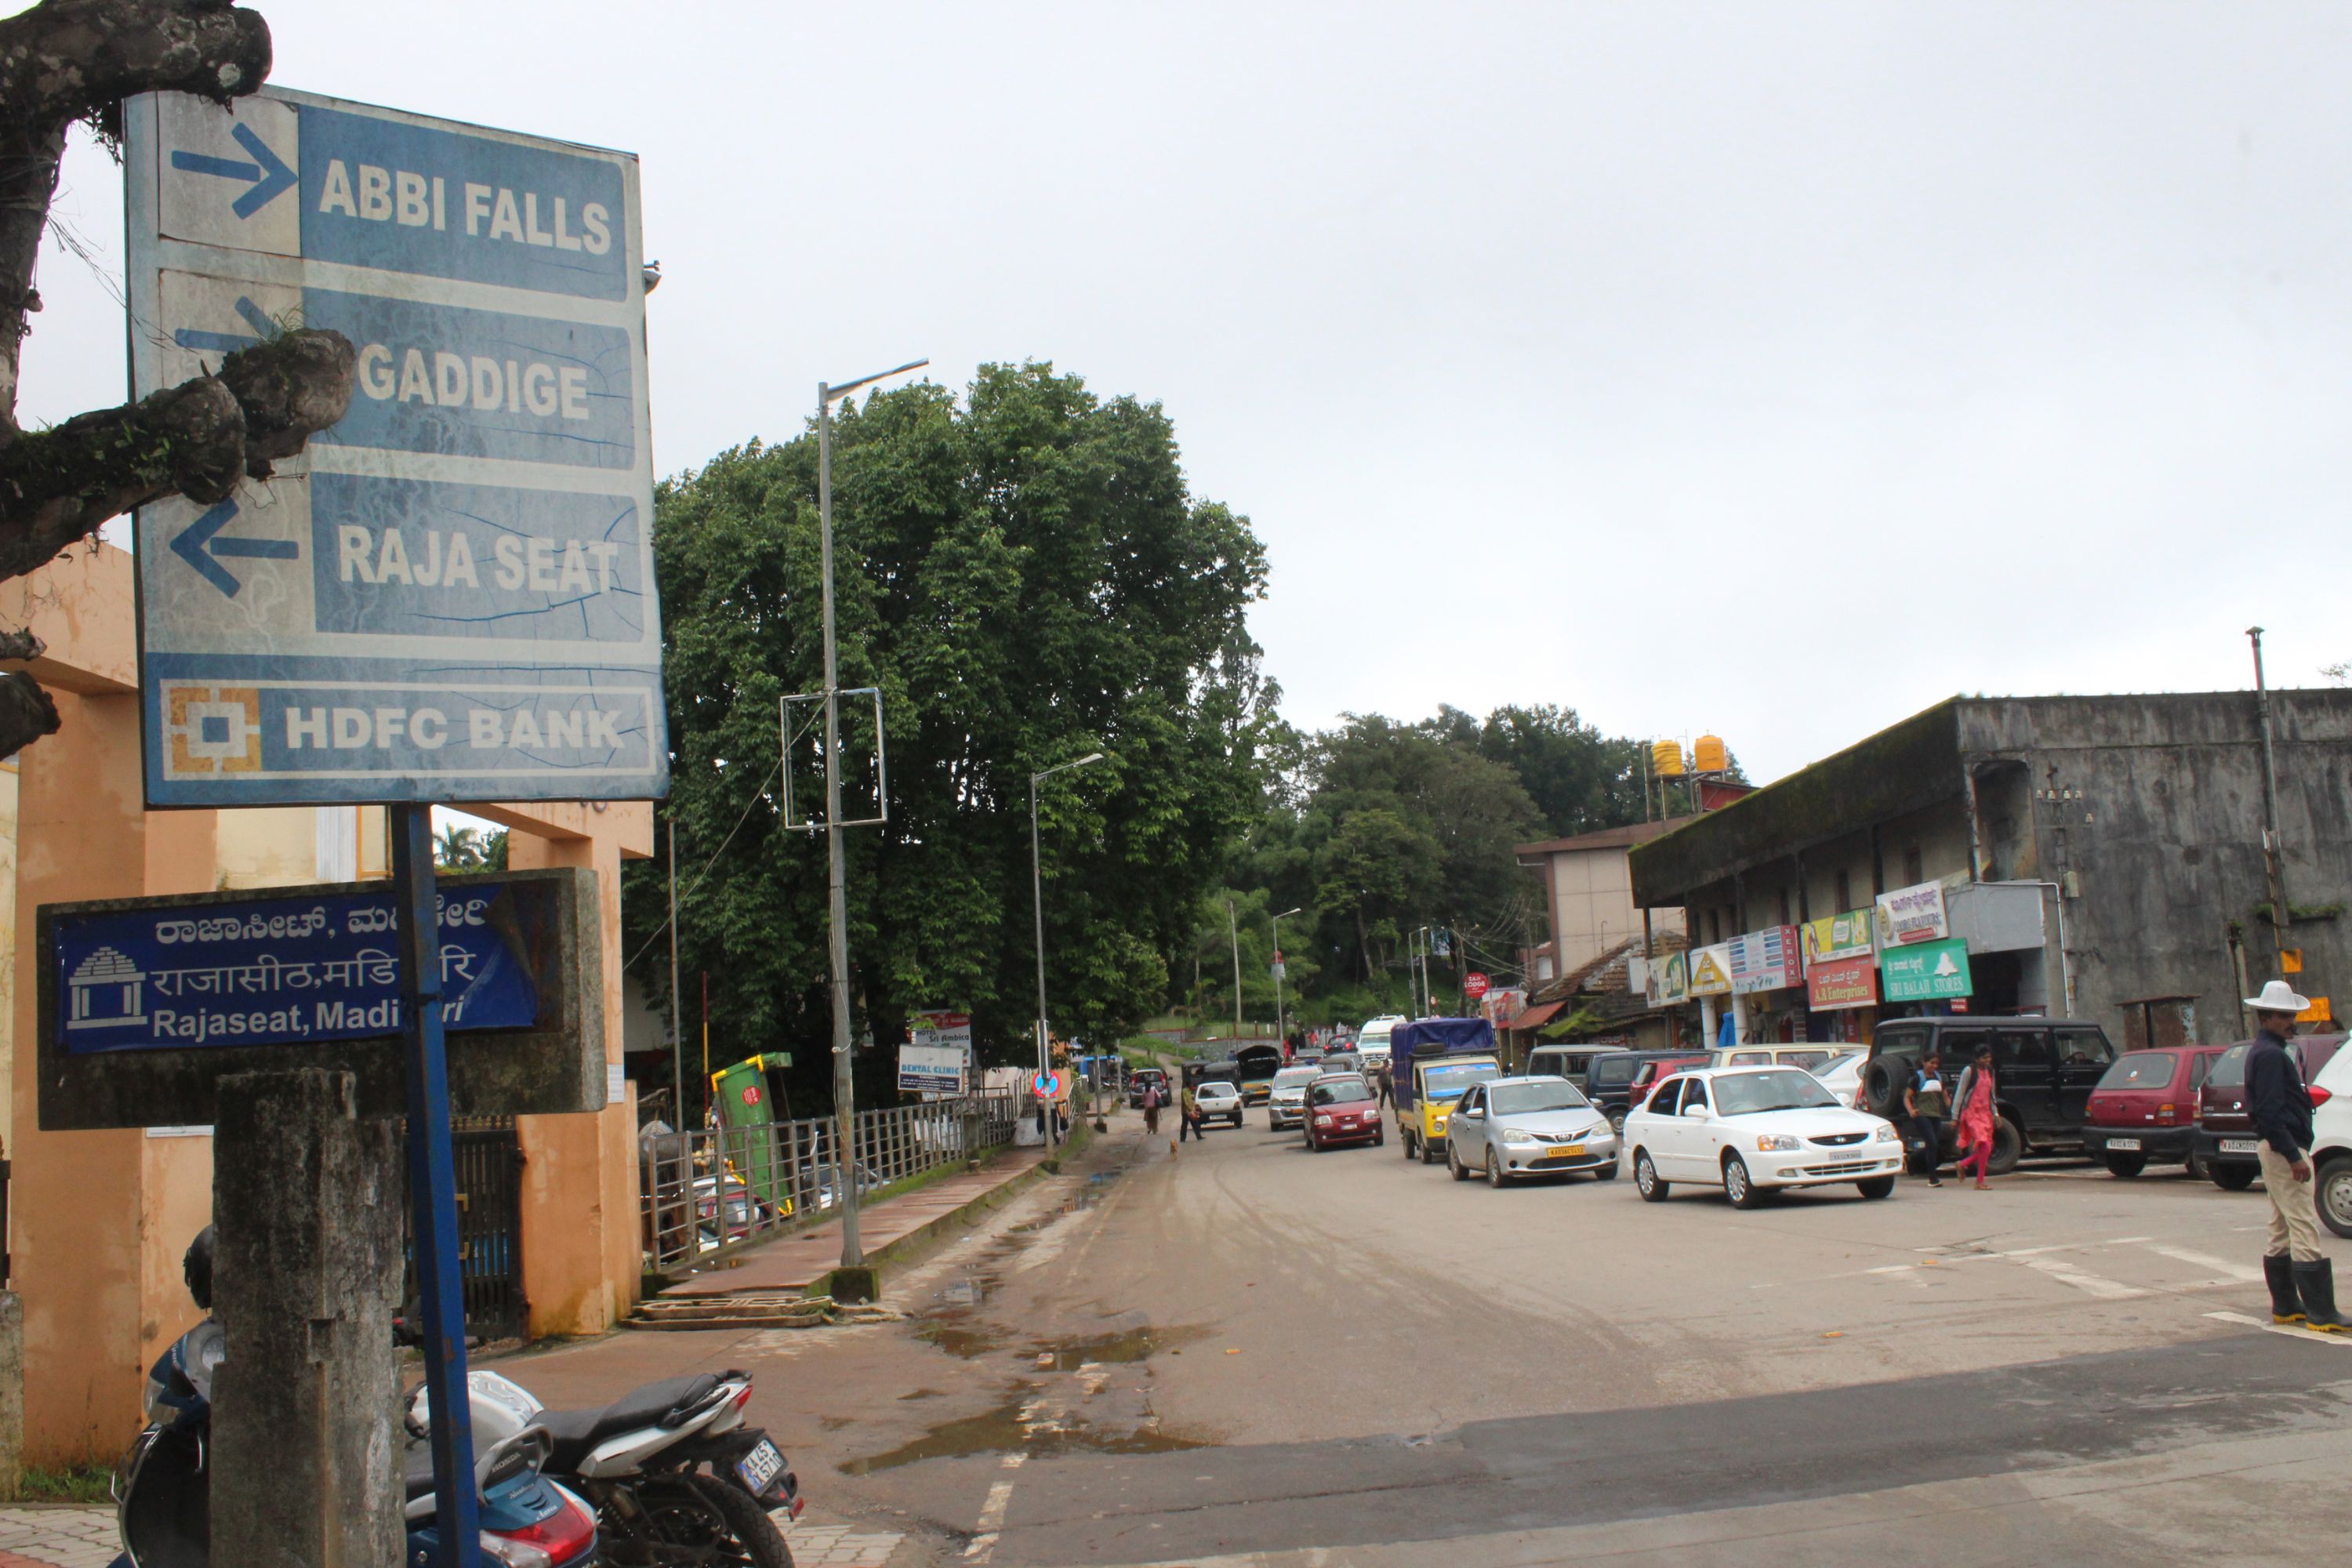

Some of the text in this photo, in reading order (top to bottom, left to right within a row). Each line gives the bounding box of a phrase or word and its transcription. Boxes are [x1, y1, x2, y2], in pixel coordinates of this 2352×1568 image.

[319, 160, 611, 256] ABBI FALLS
[358, 343, 590, 420] GADDIGE
[338, 524, 619, 593] RAJA SEAT
[286, 707, 625, 750] HDFC BANK
[1784, 927, 1796, 976] XEROX
[1828, 983, 1869, 1001] Enterprises
[1890, 975, 1964, 996] SRI BALAJI STORES
[154, 995, 466, 1044] Rajaseat, Madiri
[941, 1033, 970, 1043] Ambica
[902, 1063, 960, 1075] DENTAL CLINIC
[490, 1451, 521, 1473] HONDA
[755, 1445, 768, 1462] 45
[759, 1453, 782, 1478] 5710
